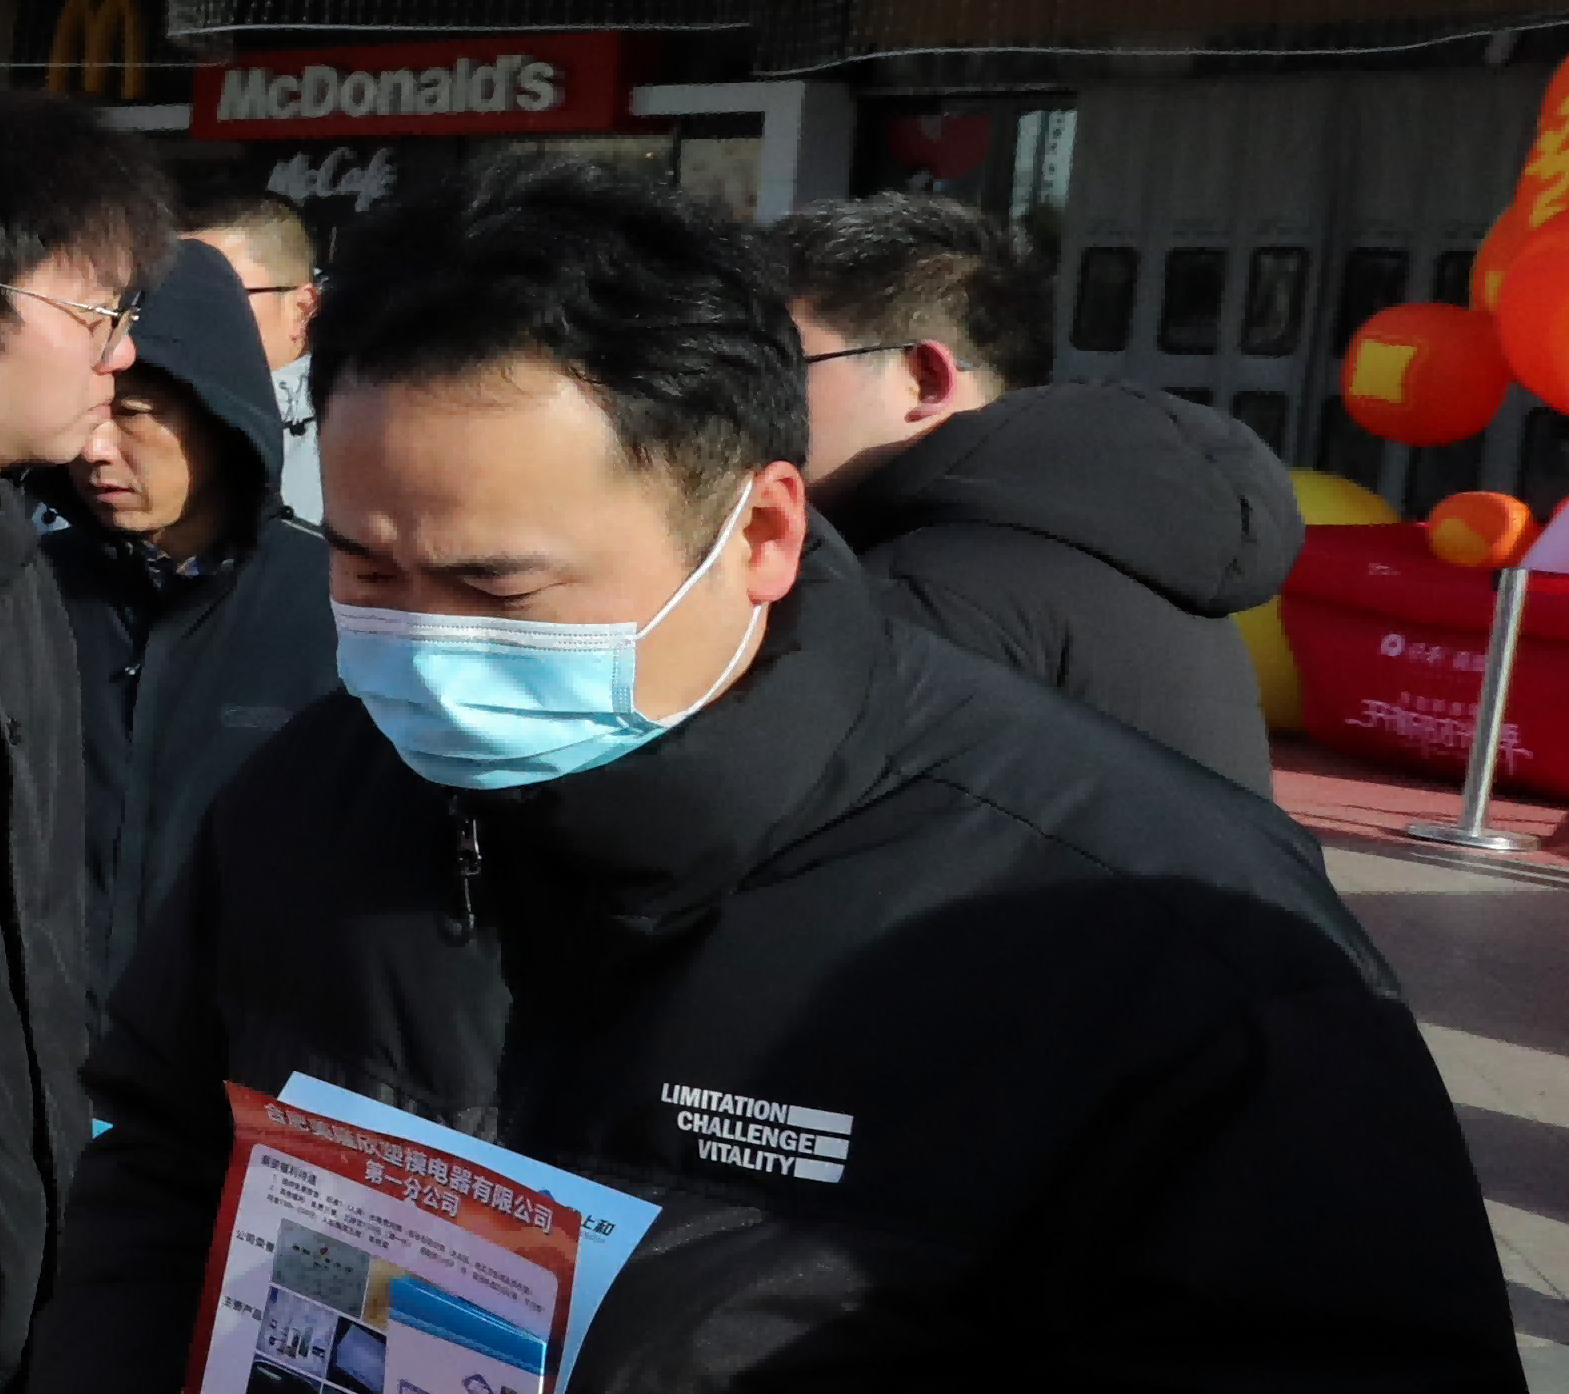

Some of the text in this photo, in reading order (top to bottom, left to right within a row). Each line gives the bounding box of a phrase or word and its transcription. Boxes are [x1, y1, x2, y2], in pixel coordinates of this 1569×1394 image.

[215, 53, 559, 124] McDonald's
[660, 1082, 789, 1124] LIMITATION
[676, 1110, 815, 1154] CHALLENGE
[697, 1138, 796, 1176] VITALITY
[364, 1158, 461, 1220] 第一分公司
